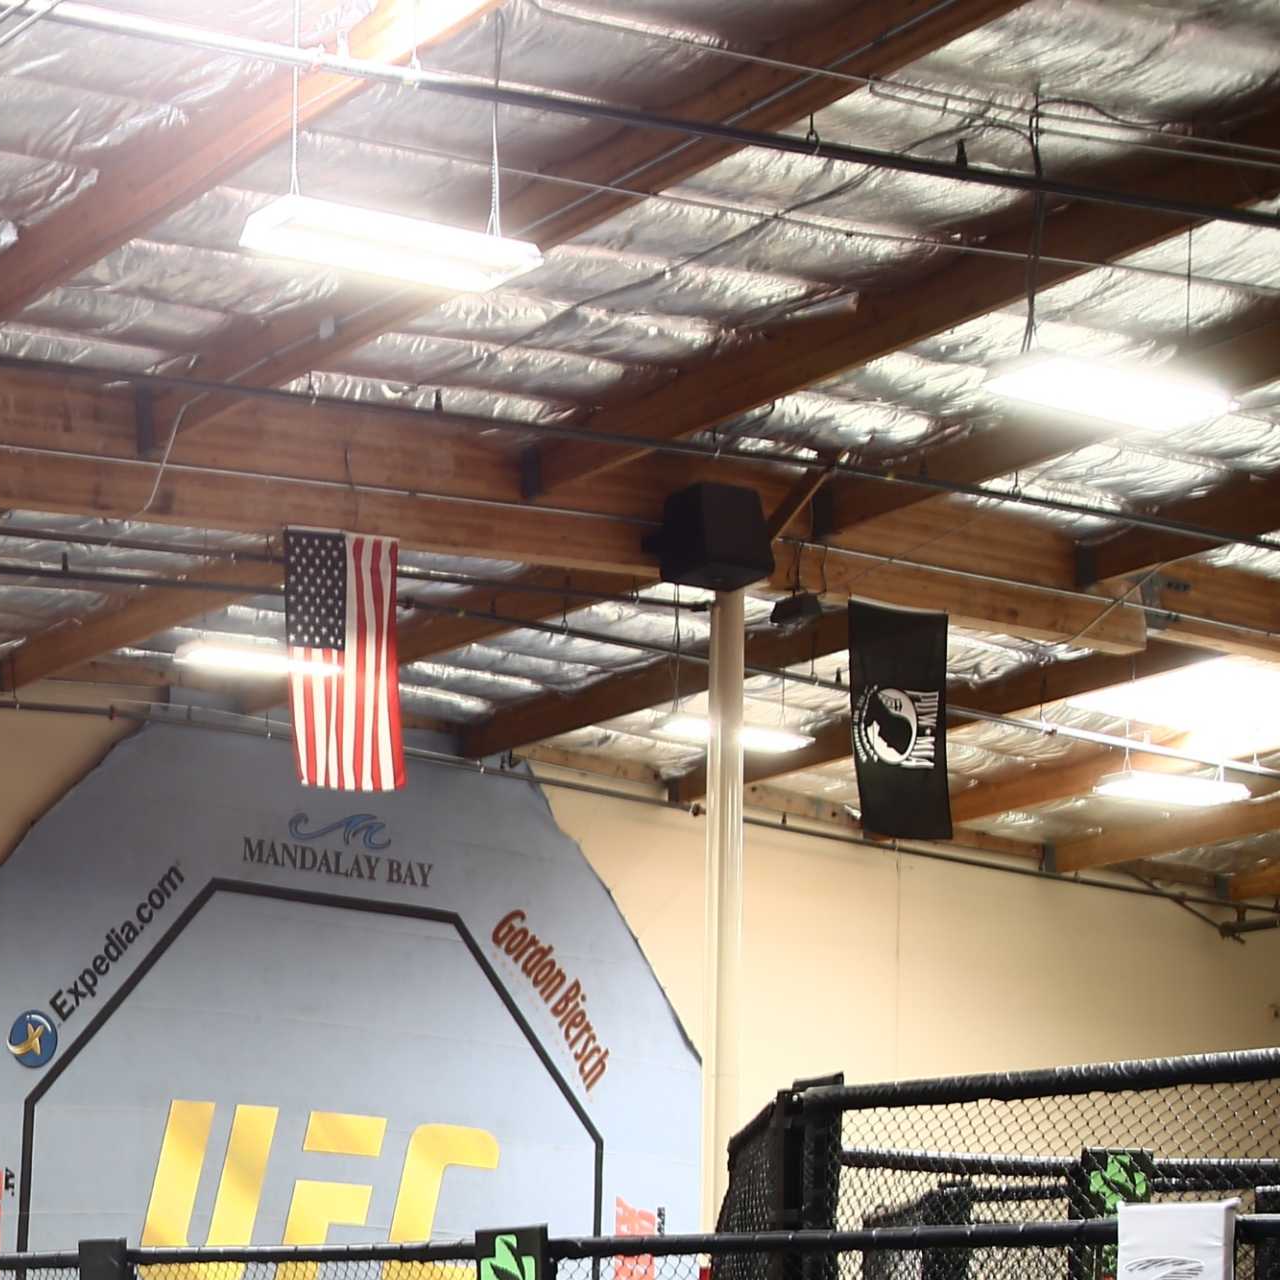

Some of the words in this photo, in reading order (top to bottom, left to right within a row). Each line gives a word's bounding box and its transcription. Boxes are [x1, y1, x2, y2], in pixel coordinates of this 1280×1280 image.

[242, 836, 380, 881] MANDALAY
[386, 857, 435, 888] BAY
[48, 865, 185, 1022] Expedia.com
[491, 909, 567, 1004] Gordon
[550, 978, 610, 1093] Biersch
